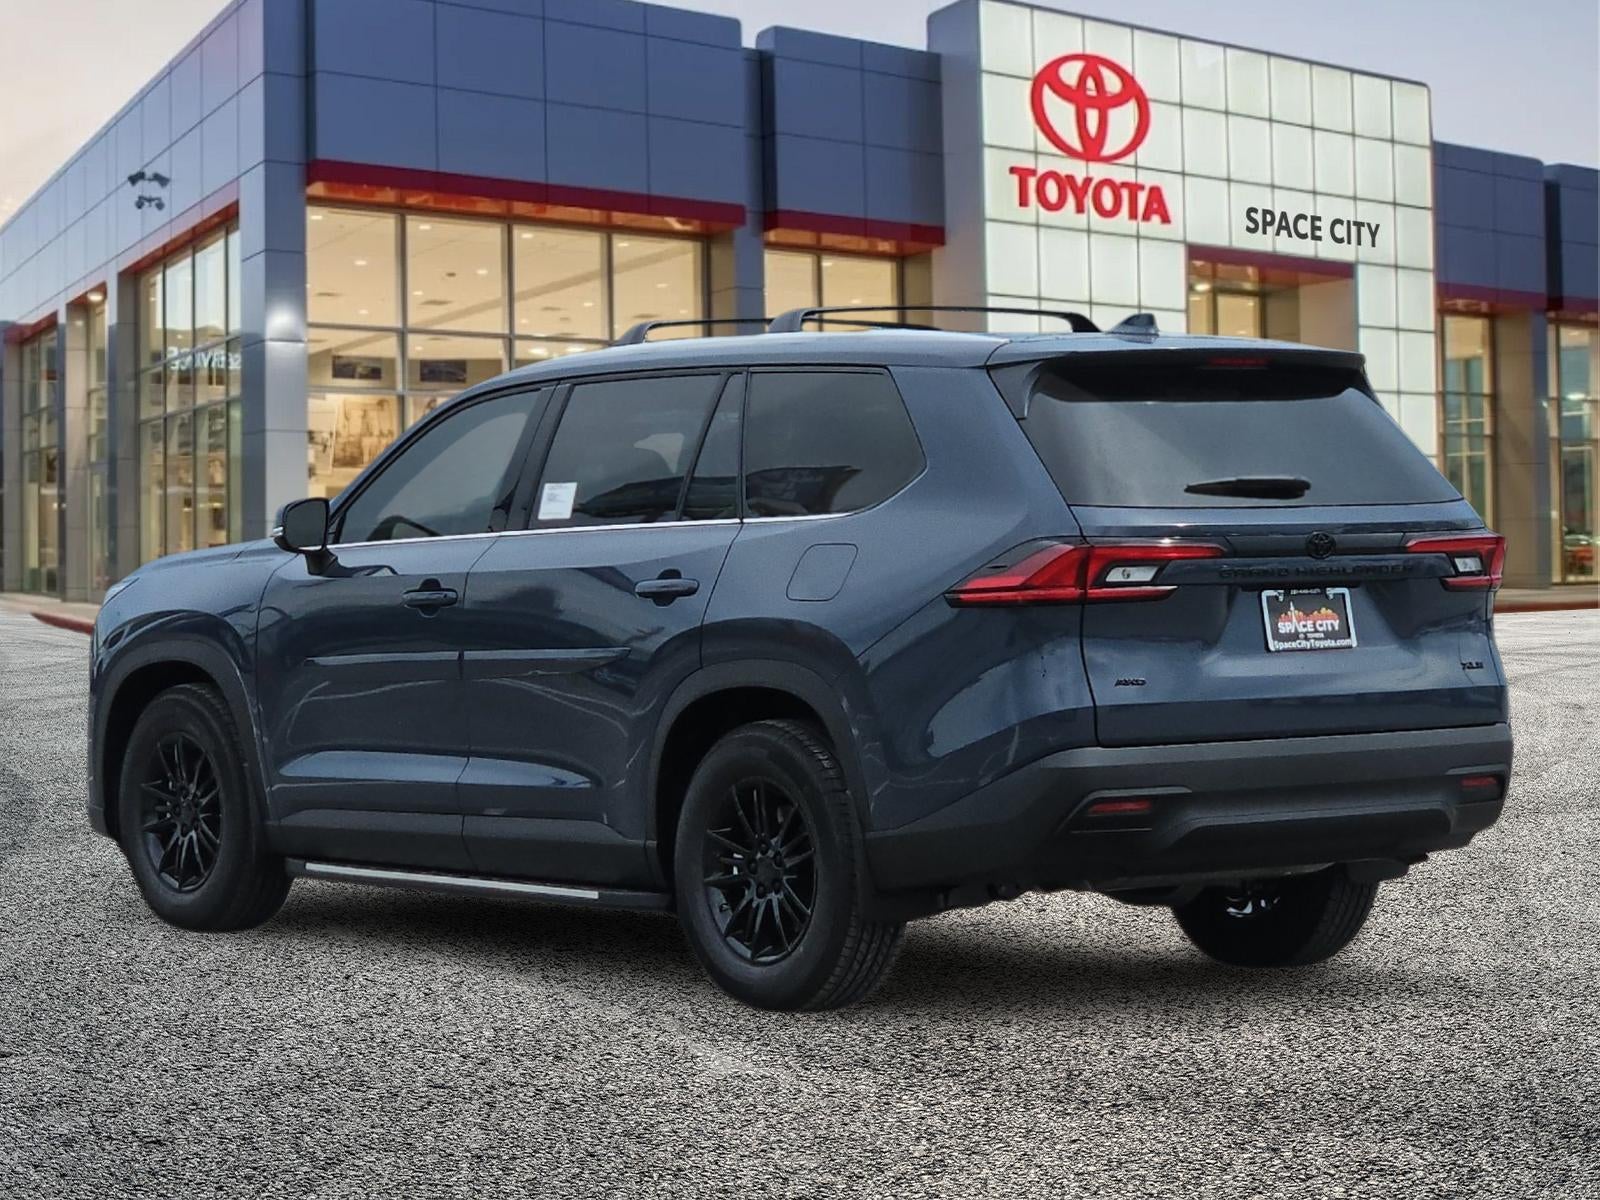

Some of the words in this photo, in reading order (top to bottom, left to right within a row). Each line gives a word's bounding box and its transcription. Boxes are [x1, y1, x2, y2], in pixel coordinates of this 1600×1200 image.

[1009, 166, 1171, 225] TOYOTA
[1245, 206, 1323, 242] SPACE
[1329, 217, 1381, 248] CITY
[1278, 621, 1315, 634] SPACE
[1316, 620, 1339, 632] CITY
[1274, 639, 1352, 649] SpaceCityToyota.com
